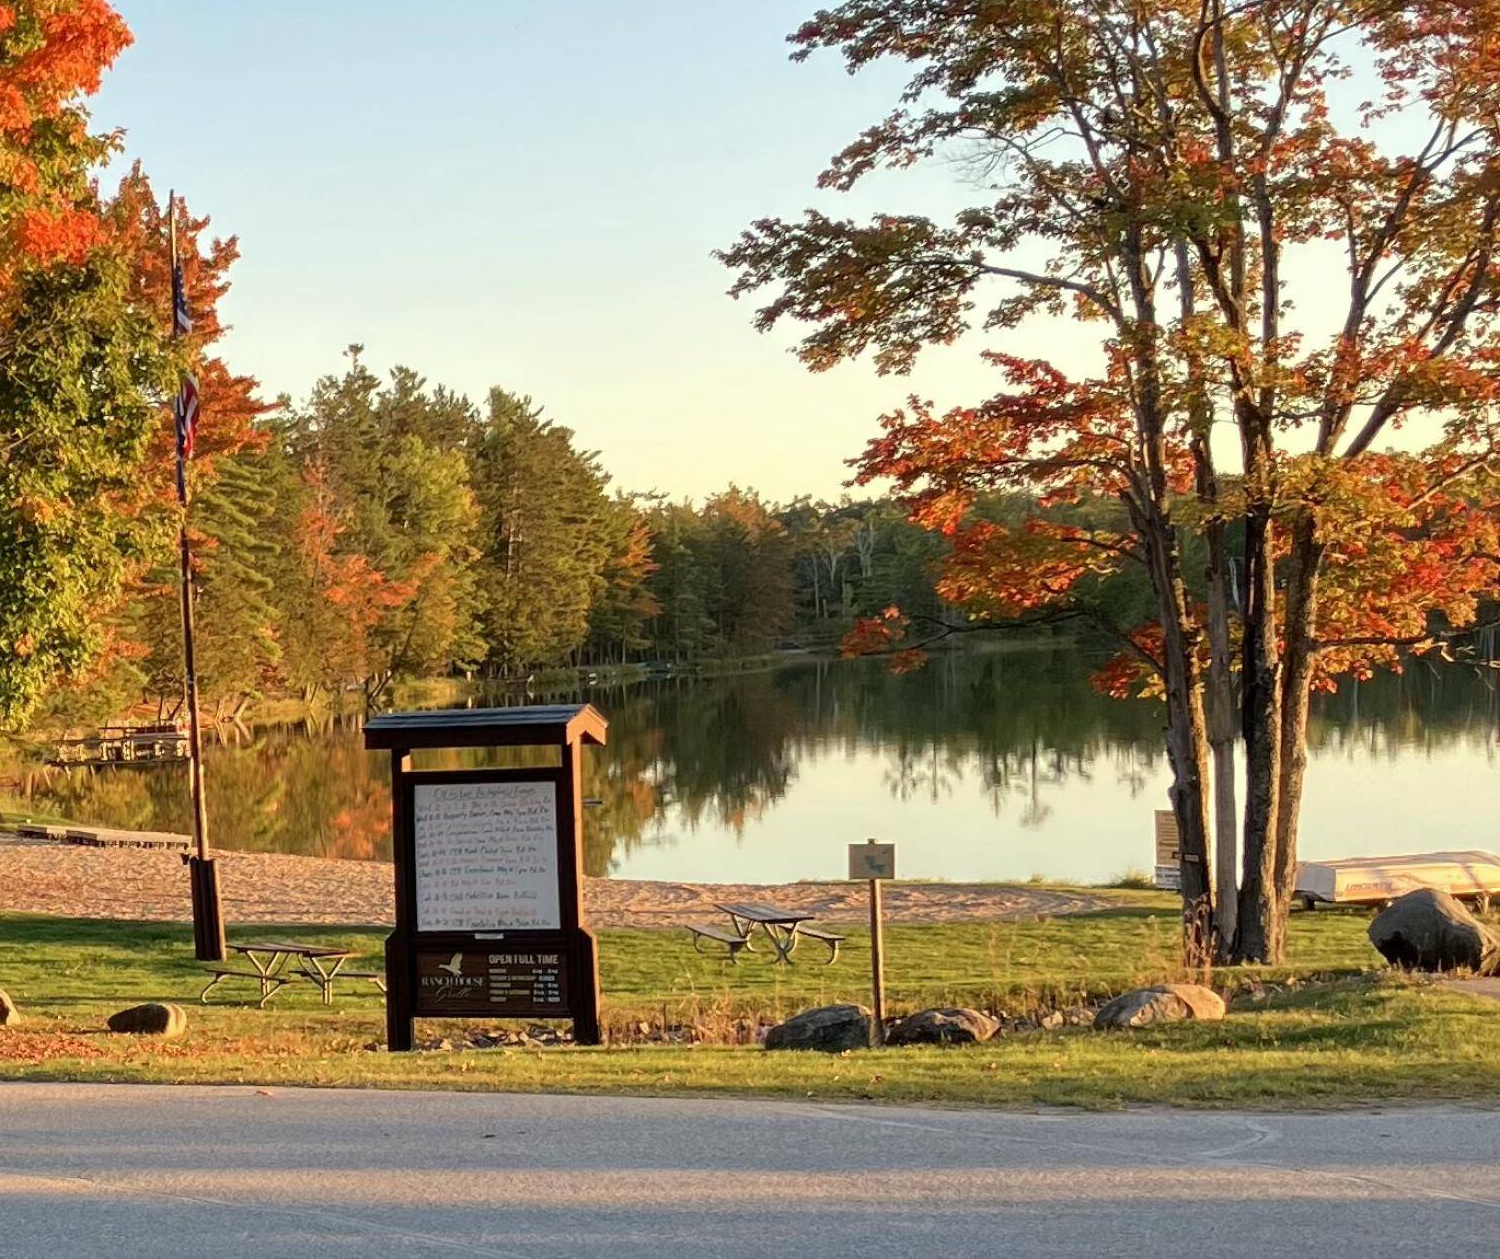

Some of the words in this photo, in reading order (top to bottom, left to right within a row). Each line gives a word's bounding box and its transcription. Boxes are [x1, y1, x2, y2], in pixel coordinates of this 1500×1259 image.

[488, 954, 512, 964] OPEN
[513, 954, 535, 964] FULL
[536, 954, 559, 964] TIME
